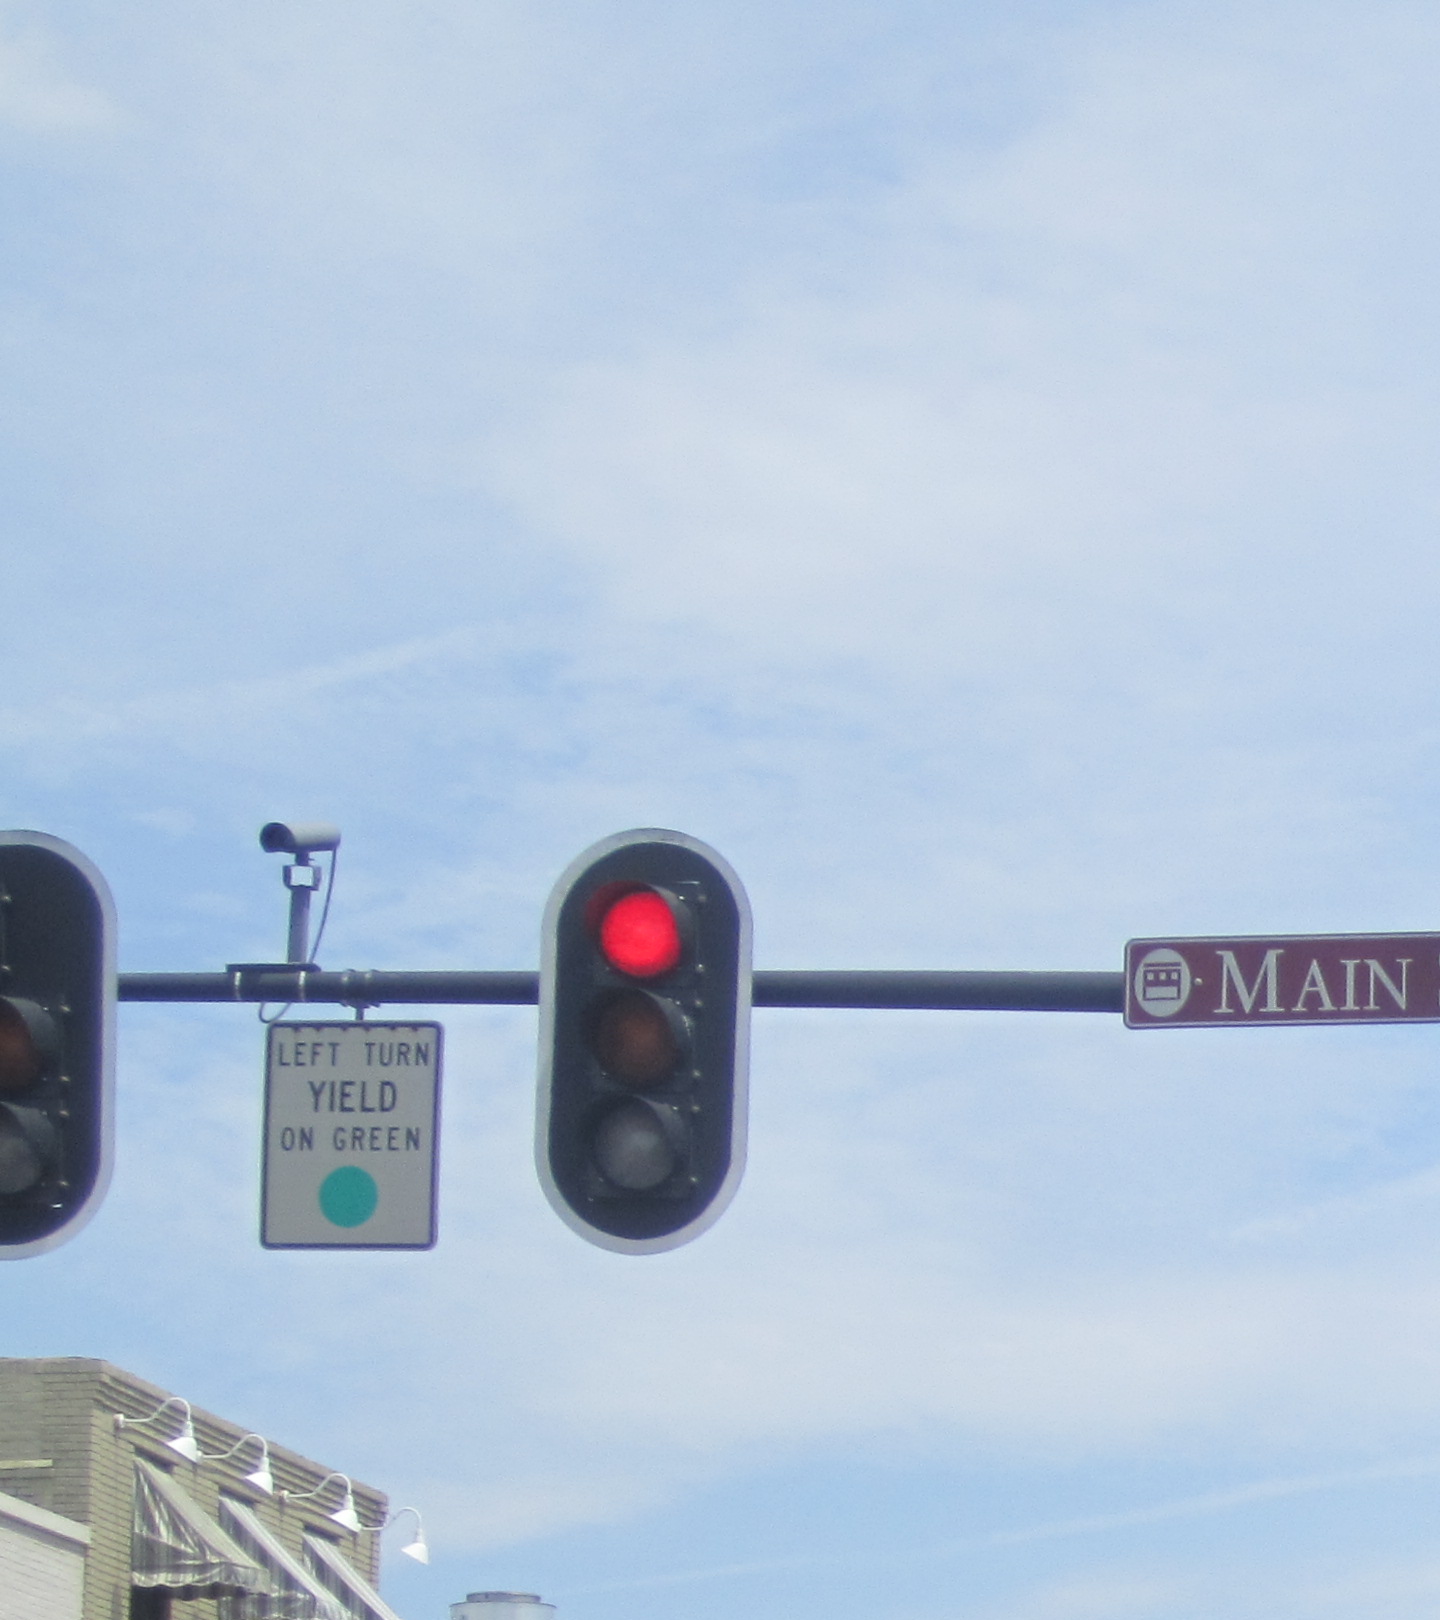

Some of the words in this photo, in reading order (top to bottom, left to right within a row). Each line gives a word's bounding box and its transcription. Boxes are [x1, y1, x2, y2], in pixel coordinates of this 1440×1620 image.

[1213, 948, 1412, 1014] MAIN
[277, 1042, 340, 1068] LEFT
[365, 1041, 431, 1068] TURN
[308, 1081, 398, 1114] YIELD
[280, 1127, 313, 1153] ON
[333, 1127, 421, 1153] GREEN
